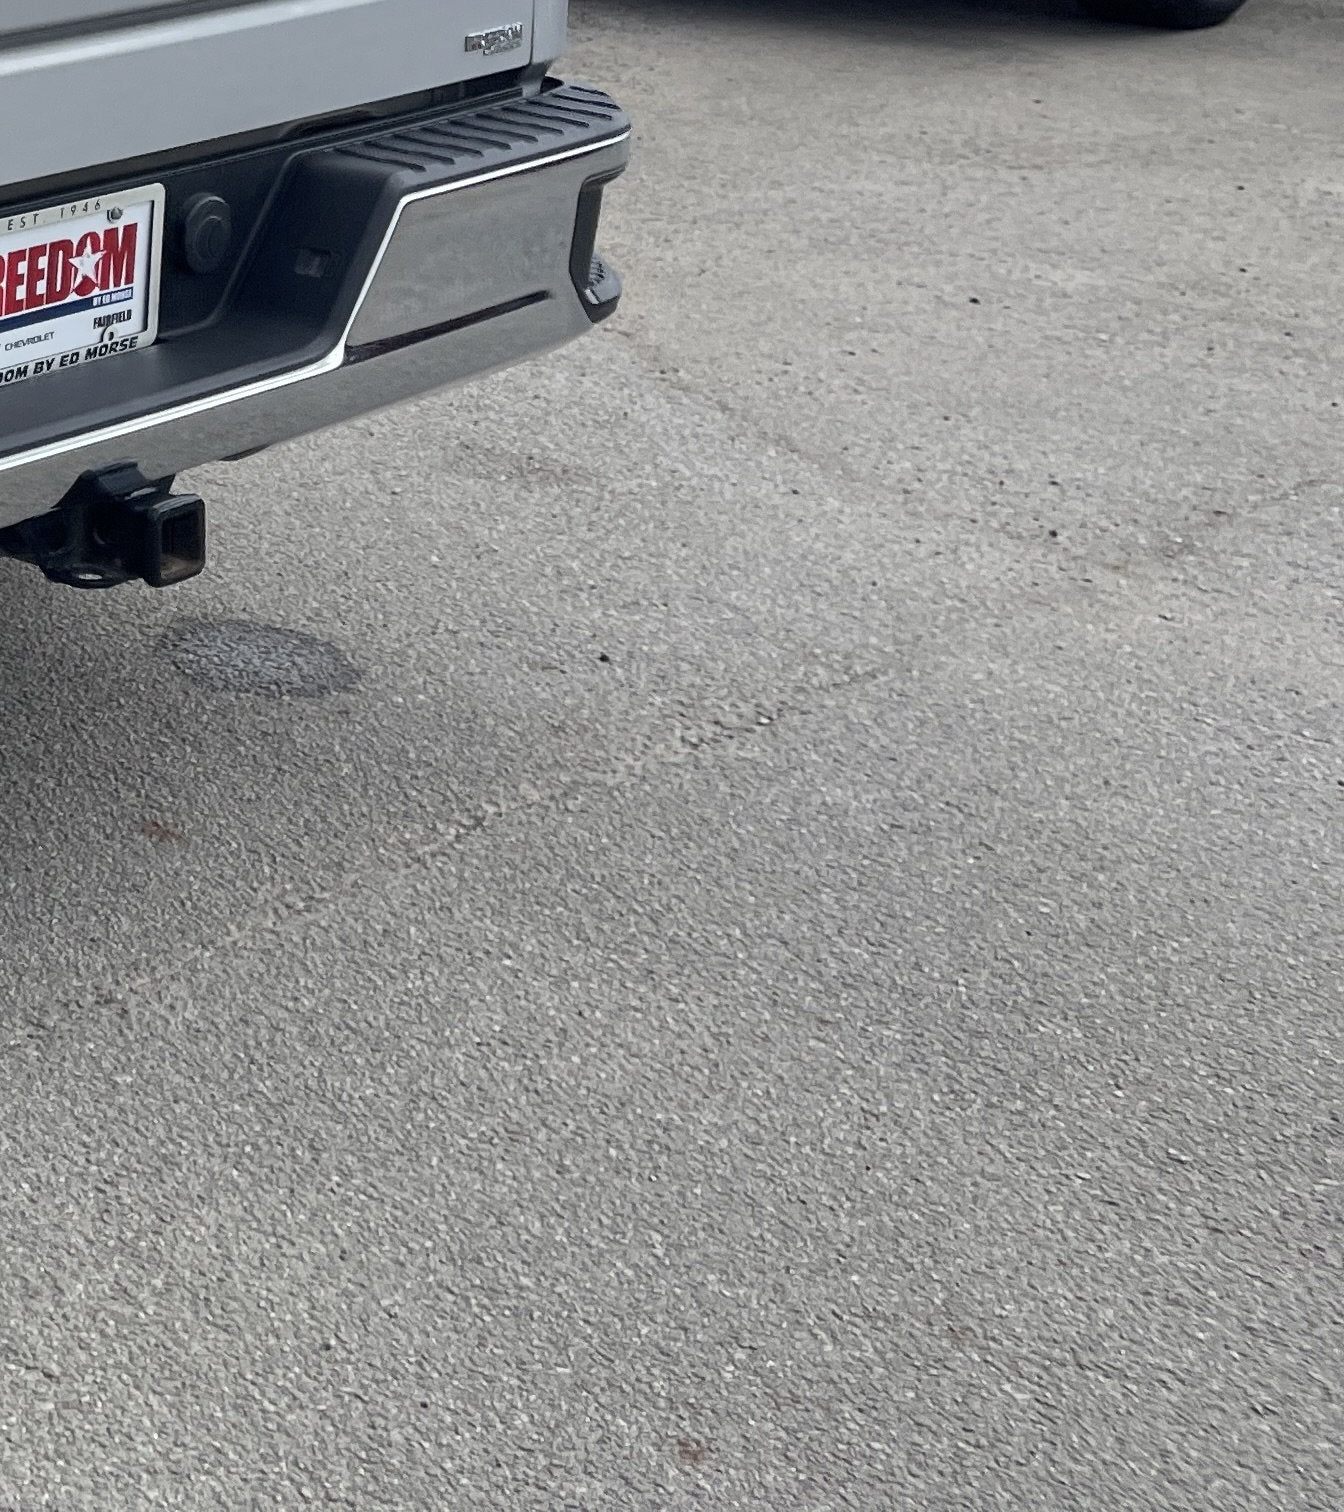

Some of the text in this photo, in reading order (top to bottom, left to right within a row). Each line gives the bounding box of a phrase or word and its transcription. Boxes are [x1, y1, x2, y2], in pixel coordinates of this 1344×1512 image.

[60, 199, 101, 219] 1946
[4, 331, 55, 351] CHEVROLET
[33, 357, 56, 375] BY
[59, 353, 80, 368] ED
[85, 336, 139, 361] MORSE
